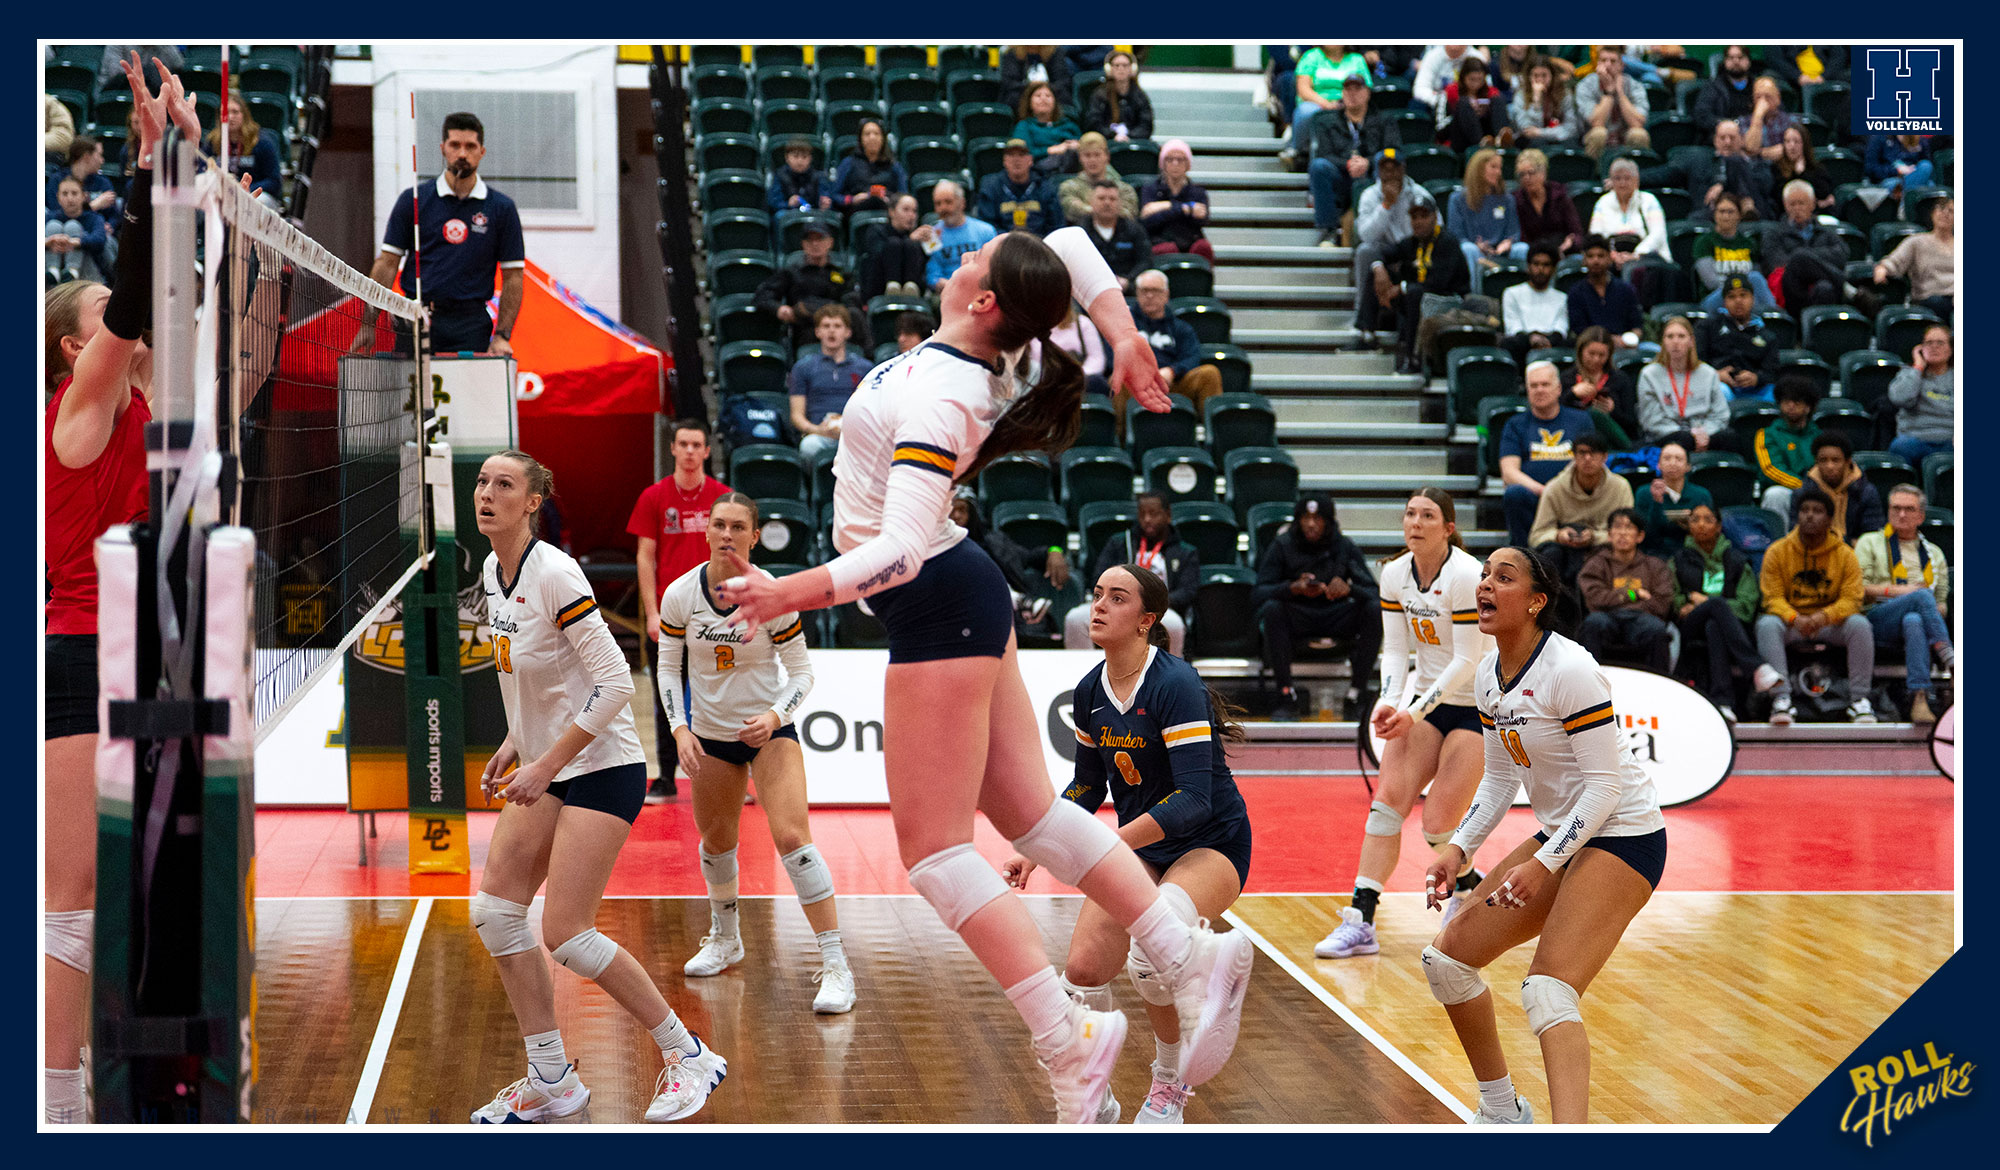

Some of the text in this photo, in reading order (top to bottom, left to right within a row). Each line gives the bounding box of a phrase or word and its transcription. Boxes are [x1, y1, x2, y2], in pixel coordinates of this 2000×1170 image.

[695, 625, 744, 644] Humbe
[1411, 617, 1441, 646] 12
[494, 634, 513, 675] 18
[714, 645, 736, 672] 2
[425, 698, 443, 803] sports imports
[1099, 725, 1147, 749] Humber
[1500, 727, 1532, 769] 10
[1114, 751, 1143, 787] 8
[1553, 815, 1586, 856] Rollhawks
